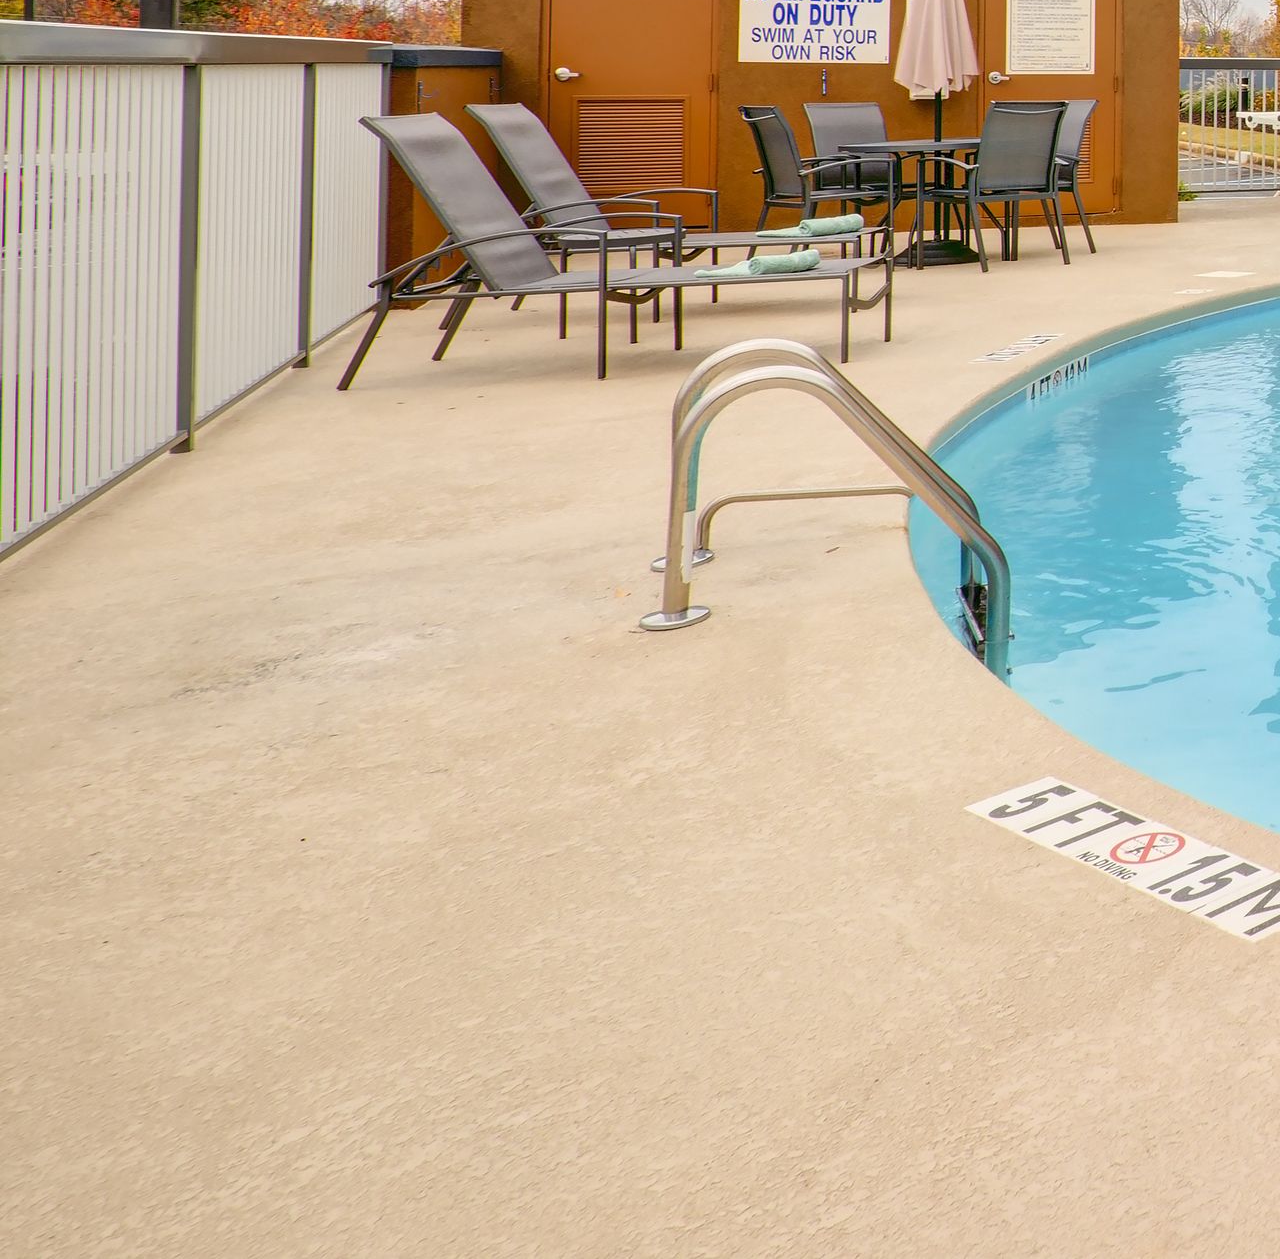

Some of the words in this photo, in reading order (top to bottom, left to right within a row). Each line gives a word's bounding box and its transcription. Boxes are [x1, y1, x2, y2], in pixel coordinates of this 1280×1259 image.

[773, 2, 799, 25] ON
[809, 4, 858, 26] DUTY
[751, 27, 794, 43] SWIM
[803, 29, 824, 43] AT
[833, 29, 877, 44] YOUR
[772, 44, 811, 60] OWN
[819, 46, 857, 60] RISK
[987, 784, 1078, 820] 5
[1021, 800, 1147, 848] FT
[1075, 851, 1101, 863] NO
[1093, 858, 1138, 881] DIVING
[1146, 853, 1262, 904] 1.5
